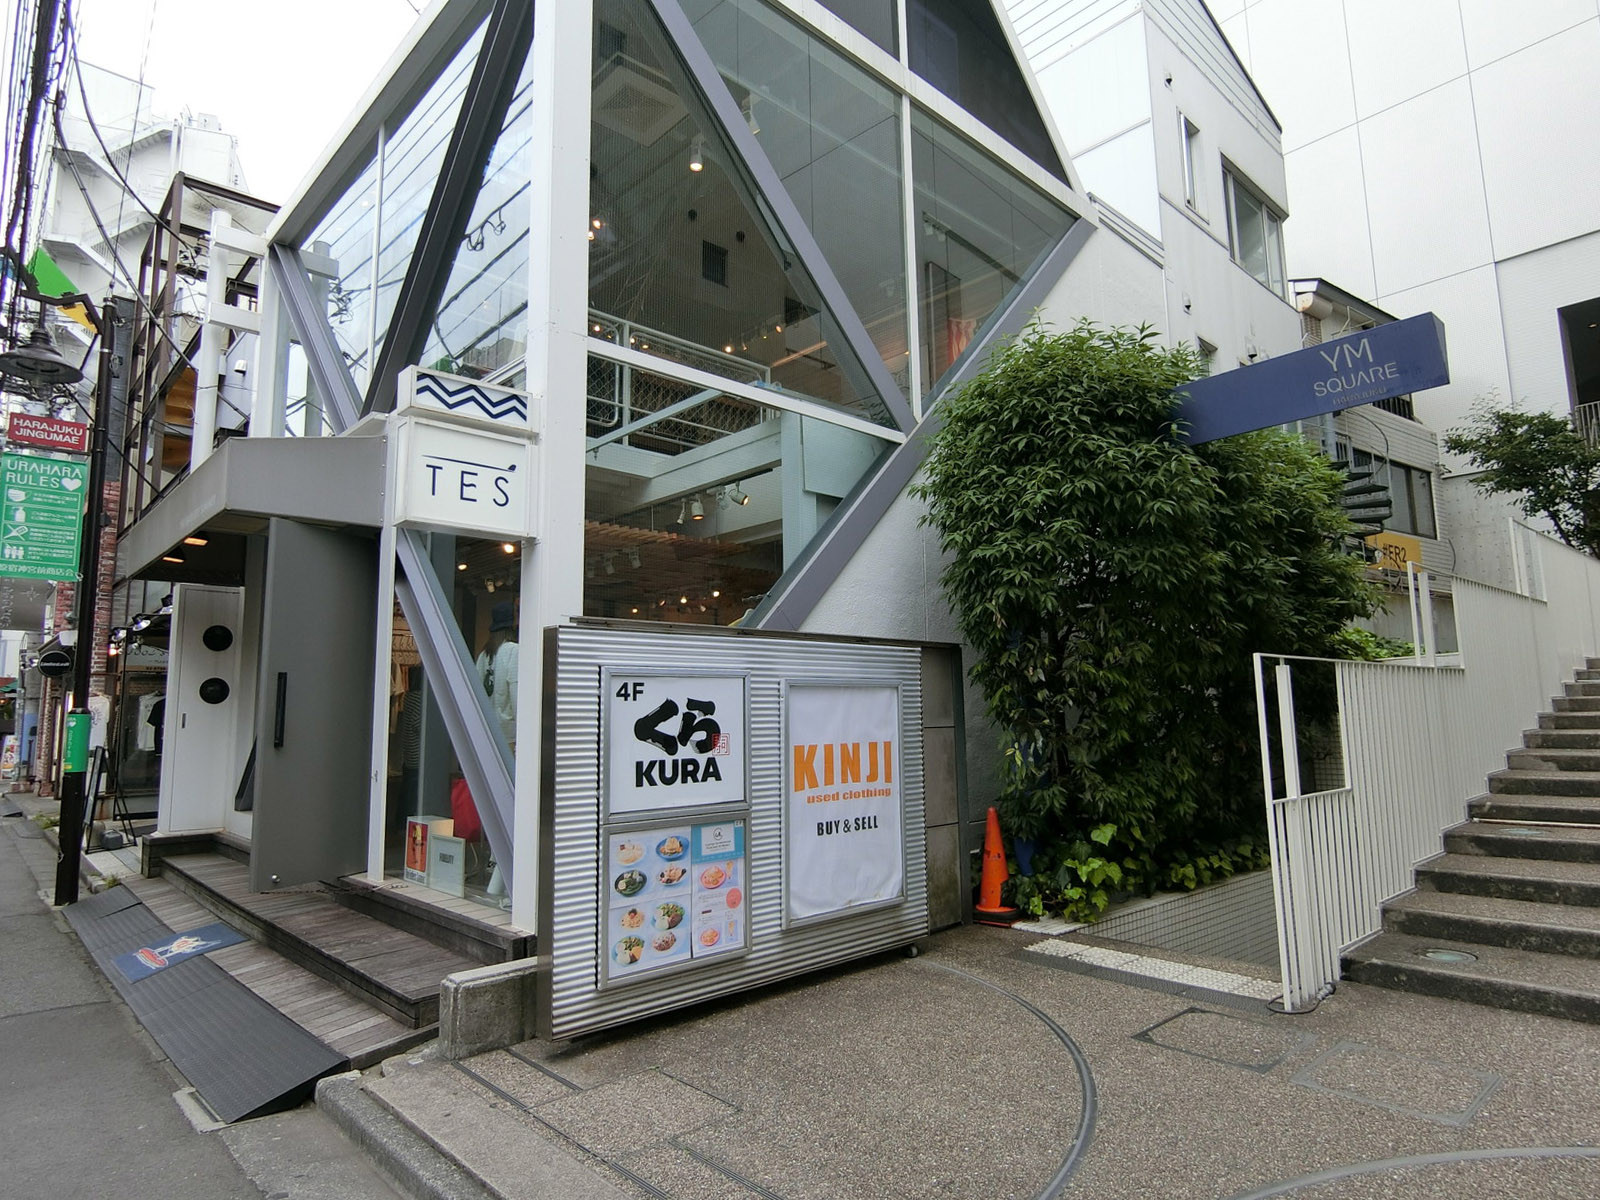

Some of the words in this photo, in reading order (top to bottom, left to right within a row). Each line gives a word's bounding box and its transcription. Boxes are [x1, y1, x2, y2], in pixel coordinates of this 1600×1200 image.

[1320, 338, 1373, 372] YM
[1313, 362, 1399, 397] SQUARE
[13, 418, 83, 436] HARAJUKU
[15, 428, 80, 445] JINGUMAE
[7, 460, 82, 478] URAHARA
[6, 472, 60, 488] RULES
[426, 464, 510, 507] TES
[616, 682, 645, 701] 4F
[634, 697, 721, 756] くら
[635, 757, 722, 788] KURA
[793, 741, 892, 792] KINJI
[807, 792, 839, 804] used
[842, 788, 891, 800] clothing
[817, 821, 840, 836] BUY
[854, 815, 878, 831] SELL
